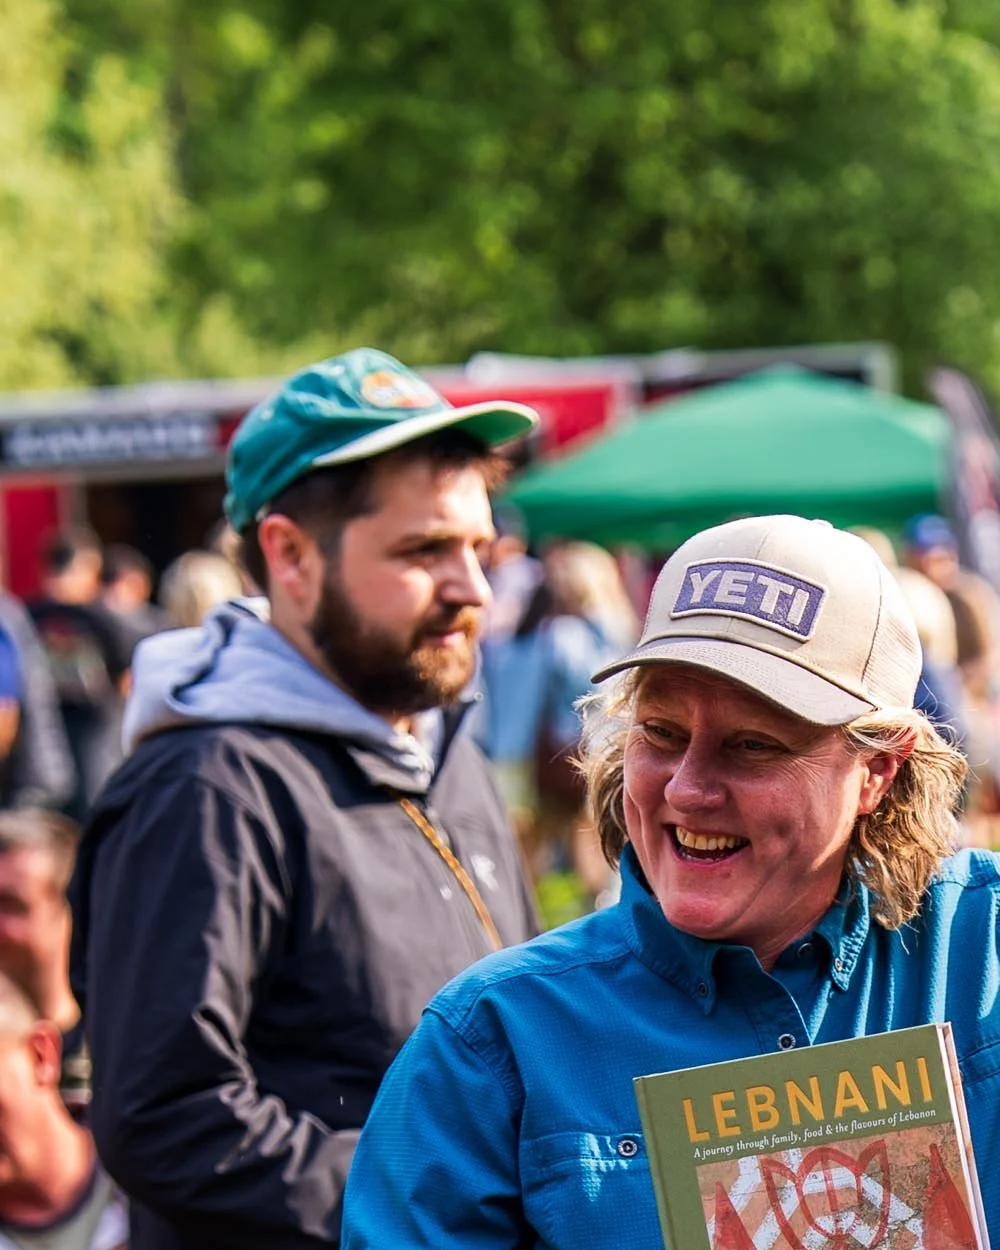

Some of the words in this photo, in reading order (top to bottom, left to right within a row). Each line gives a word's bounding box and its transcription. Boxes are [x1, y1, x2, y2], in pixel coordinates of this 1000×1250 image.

[689, 569, 810, 626] YETI
[682, 1057, 933, 1143] LEBNANI
[693, 1147, 701, 1158] A
[702, 1145, 735, 1160] journey
[736, 1136, 770, 1151] through
[771, 1130, 802, 1148] family,
[803, 1125, 823, 1142] food
[825, 1125, 833, 1135] &
[835, 1123, 849, 1133] the
[850, 1119, 886, 1134] flavours
[887, 1112, 898, 1126] of
[899, 1109, 937, 1123] Lebanon
